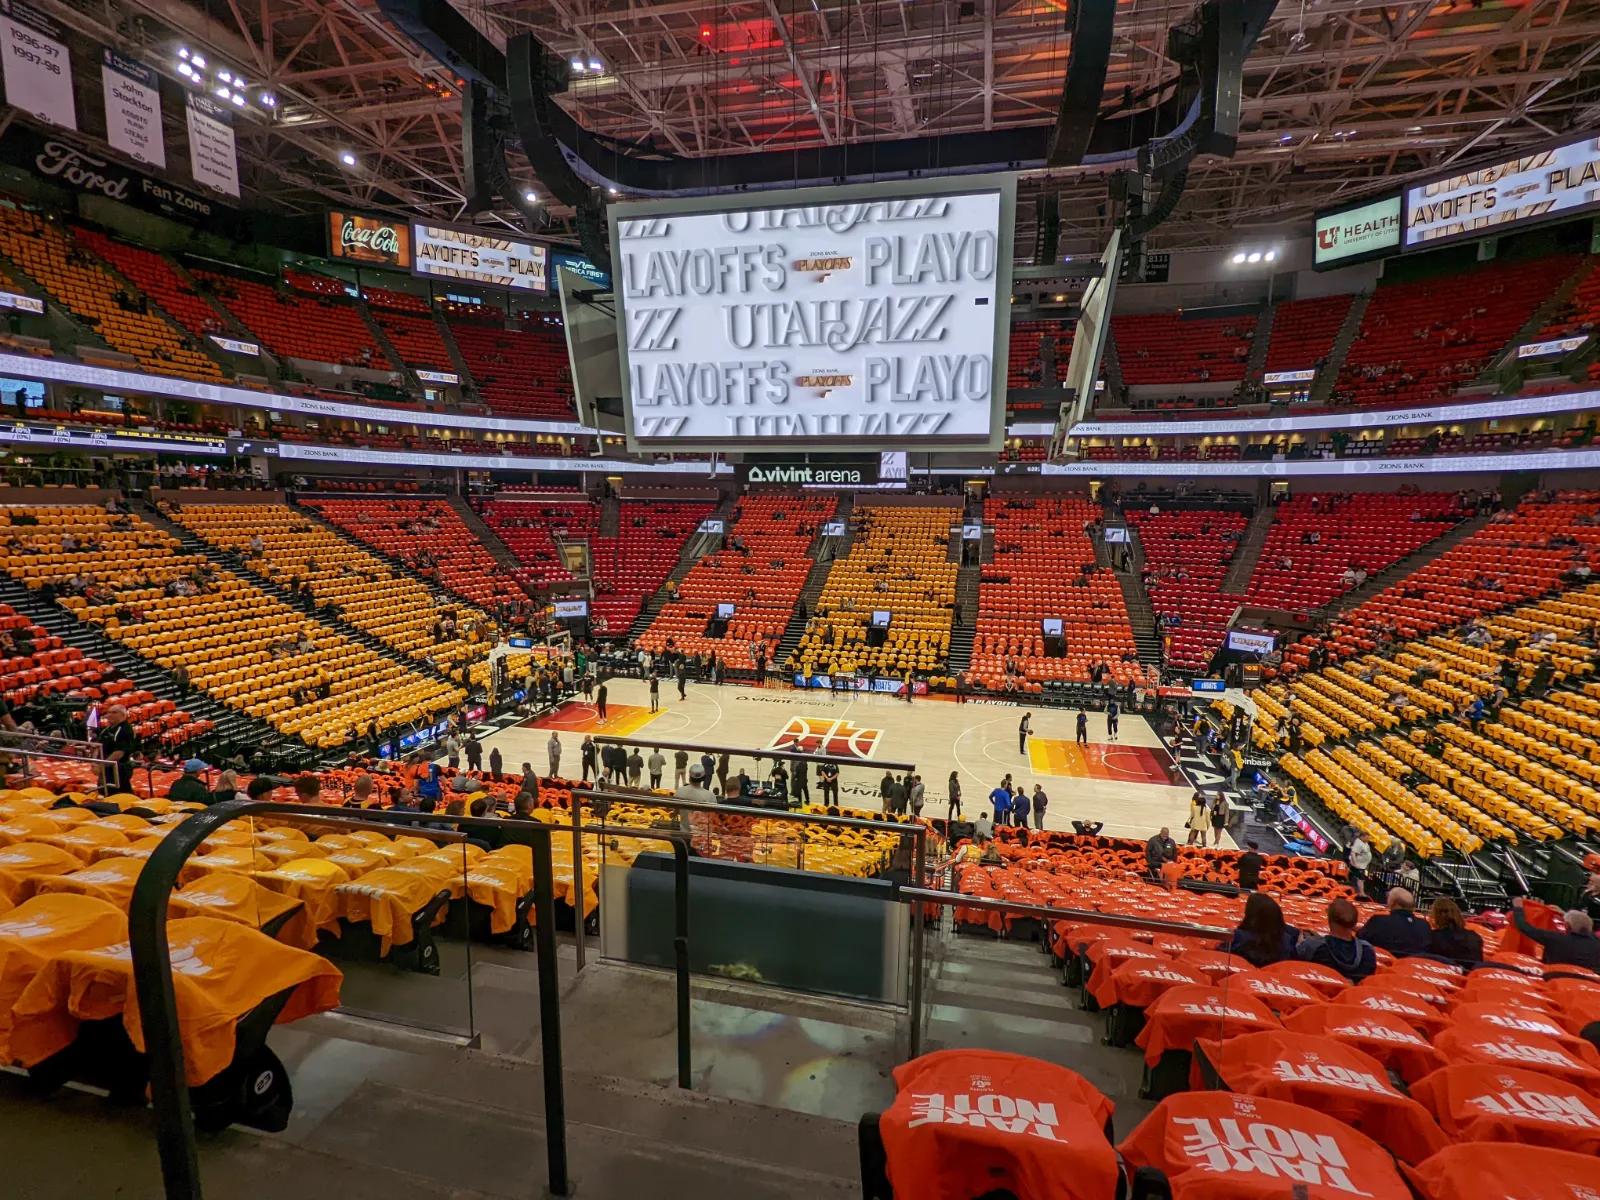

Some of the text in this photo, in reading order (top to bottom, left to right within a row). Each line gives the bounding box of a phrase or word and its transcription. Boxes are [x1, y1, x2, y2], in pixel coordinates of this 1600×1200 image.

[10, 27, 59, 58] 1996-97
[12, 44, 61, 75] 1997-98
[112, 88, 153, 113] Stockton
[121, 82, 143, 98] John
[35, 141, 128, 199] Ford
[142, 179, 212, 216] Fan Zone
[1344, 214, 1399, 238] HEALTH
[509, 256, 543, 277] PLAY
[586, 270, 604, 278] FIRST
[624, 229, 995, 298] LAYOFFS PLAYO
[799, 256, 852, 272] PLAYOFFS
[632, 354, 991, 407] LAYOFFS PLAYO
[799, 375, 853, 387] PLAYOFFS
[1386, 413, 1409, 421] ZIONS
[764, 466, 860, 482] vivint arena
[974, 698, 1018, 707] PLAYOFFS
[910, 1093, 1060, 1127] NOTE
[908, 1106, 1069, 1144] TAKE
[1172, 1116, 1350, 1169] NOTE
[1185, 1141, 1375, 1198] TAKE
